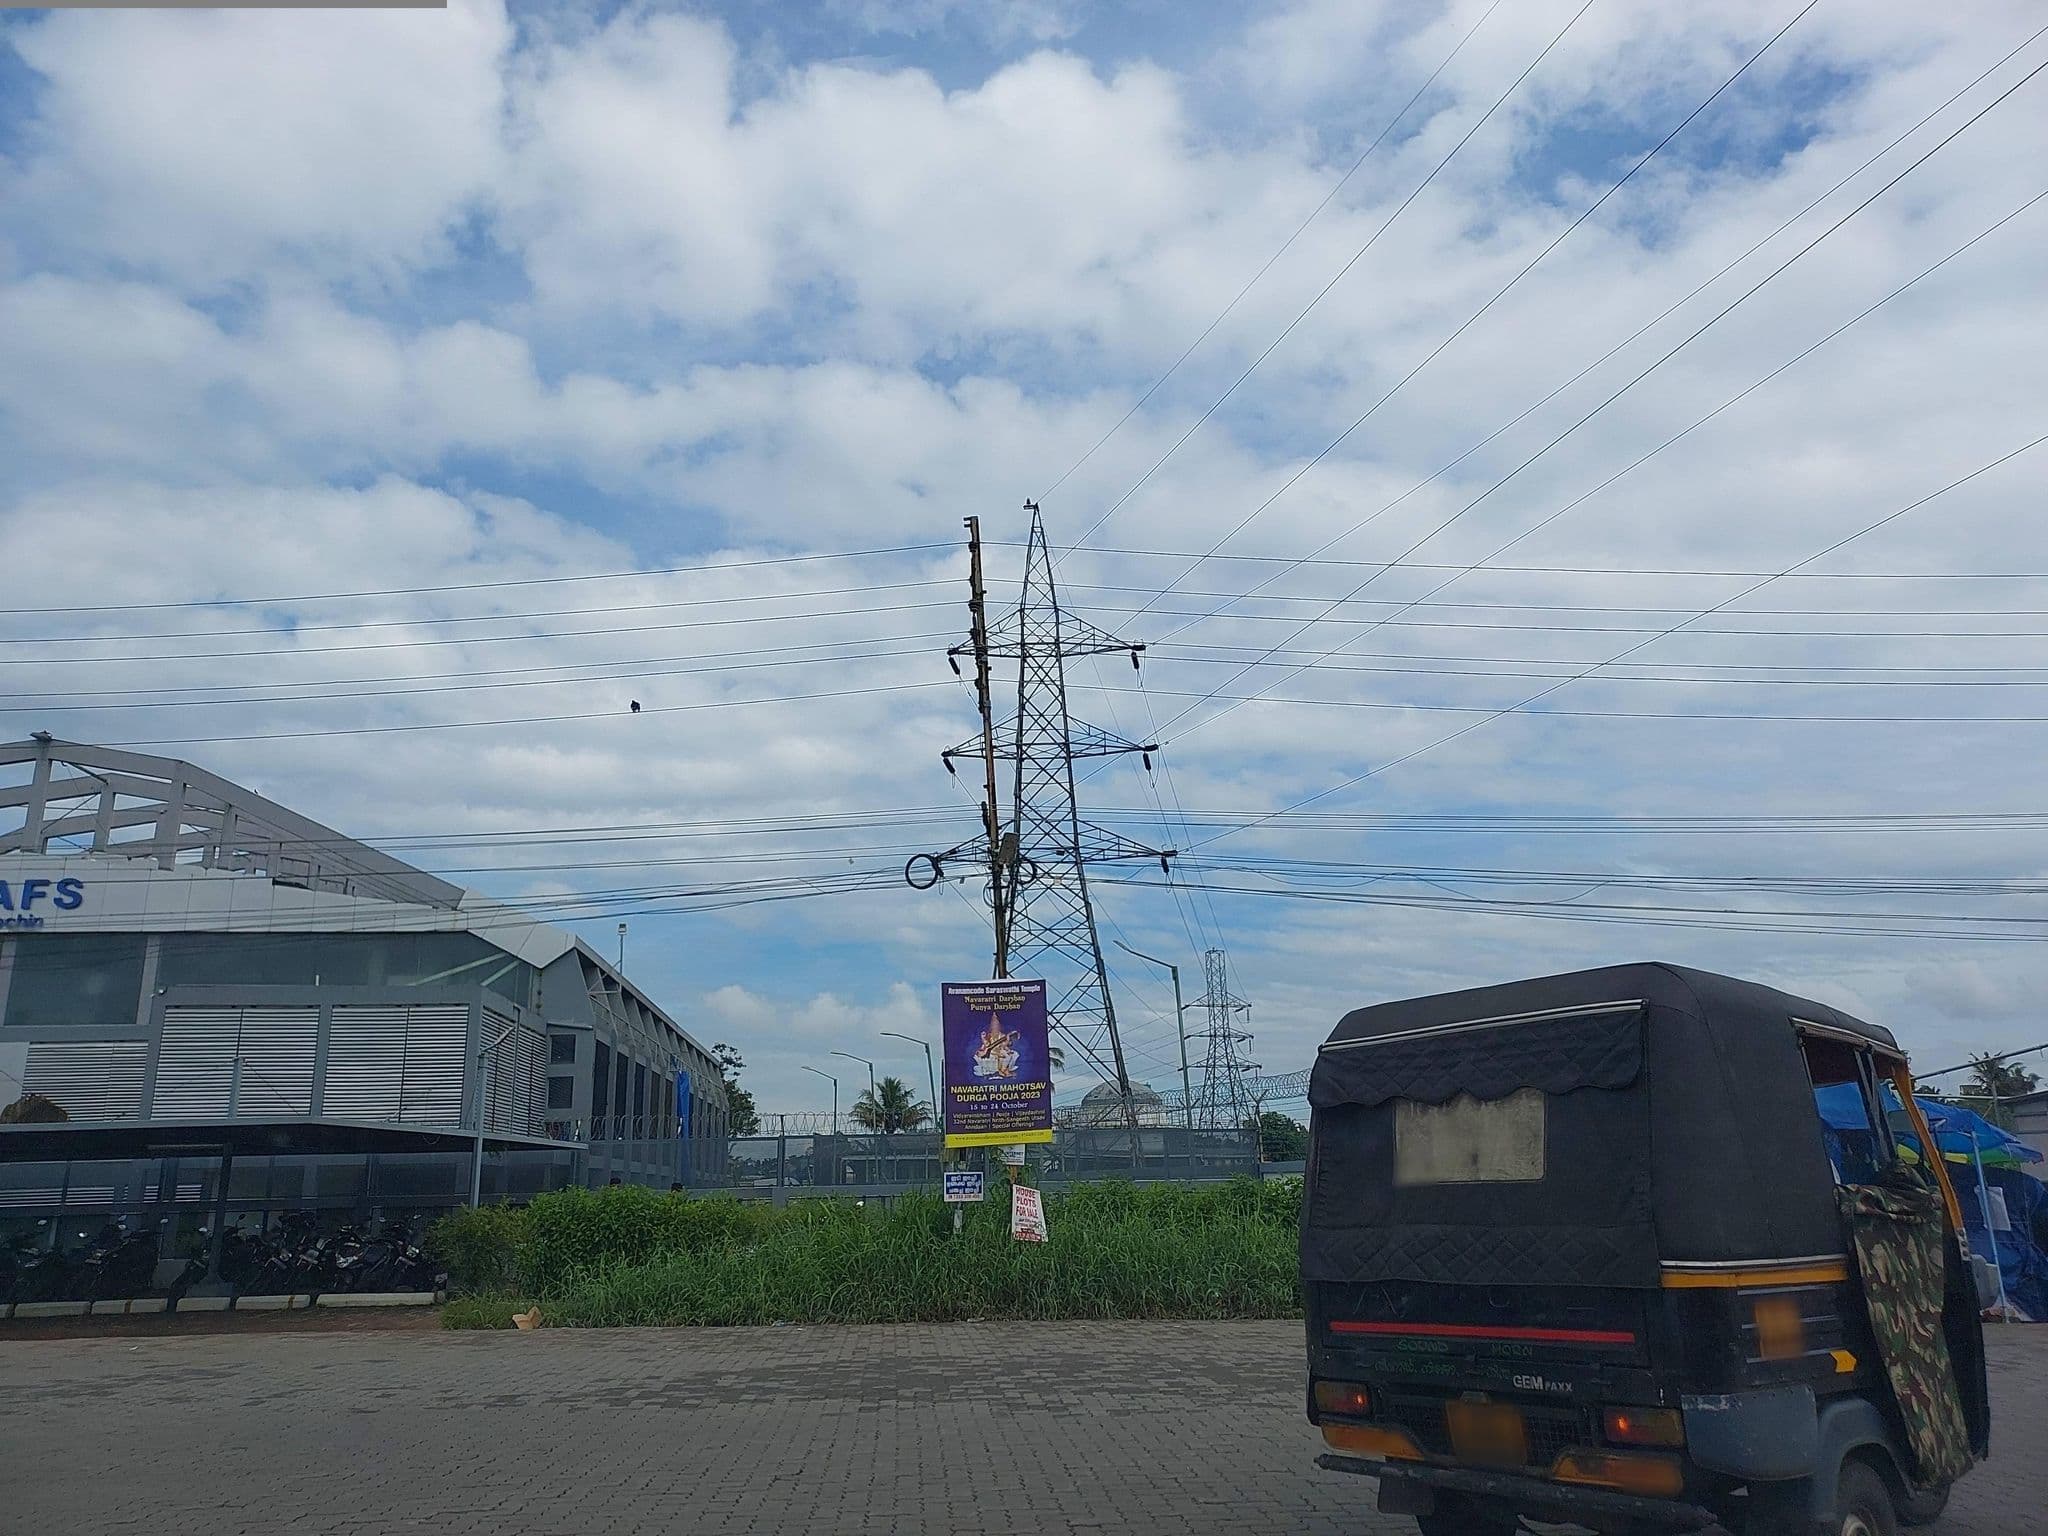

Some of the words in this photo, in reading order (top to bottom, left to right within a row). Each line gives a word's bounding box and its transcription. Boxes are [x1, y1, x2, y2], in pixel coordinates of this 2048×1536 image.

[1021, 984, 1041, 993] Temple
[964, 995, 996, 1003] Navaratri
[999, 995, 1026, 1003] Darshan
[970, 1003, 992, 1012] Punya
[994, 1003, 1021, 1011] Darshan
[950, 1085, 998, 1094] NAVARATRI
[999, 1082, 1046, 1092] MAHOTSAV
[957, 1093, 989, 1102] DURGA
[990, 1092, 1020, 1101] POOJA
[1021, 1091, 1041, 1100] 2023
[1001, 1101, 1028, 1109] October
[1015, 1186, 1036, 1199] HOUSE
[1016, 1196, 1037, 1208] PLOTS
[1015, 1205, 1027, 1217] FOR
[1512, 1374, 1544, 1391] GEM
